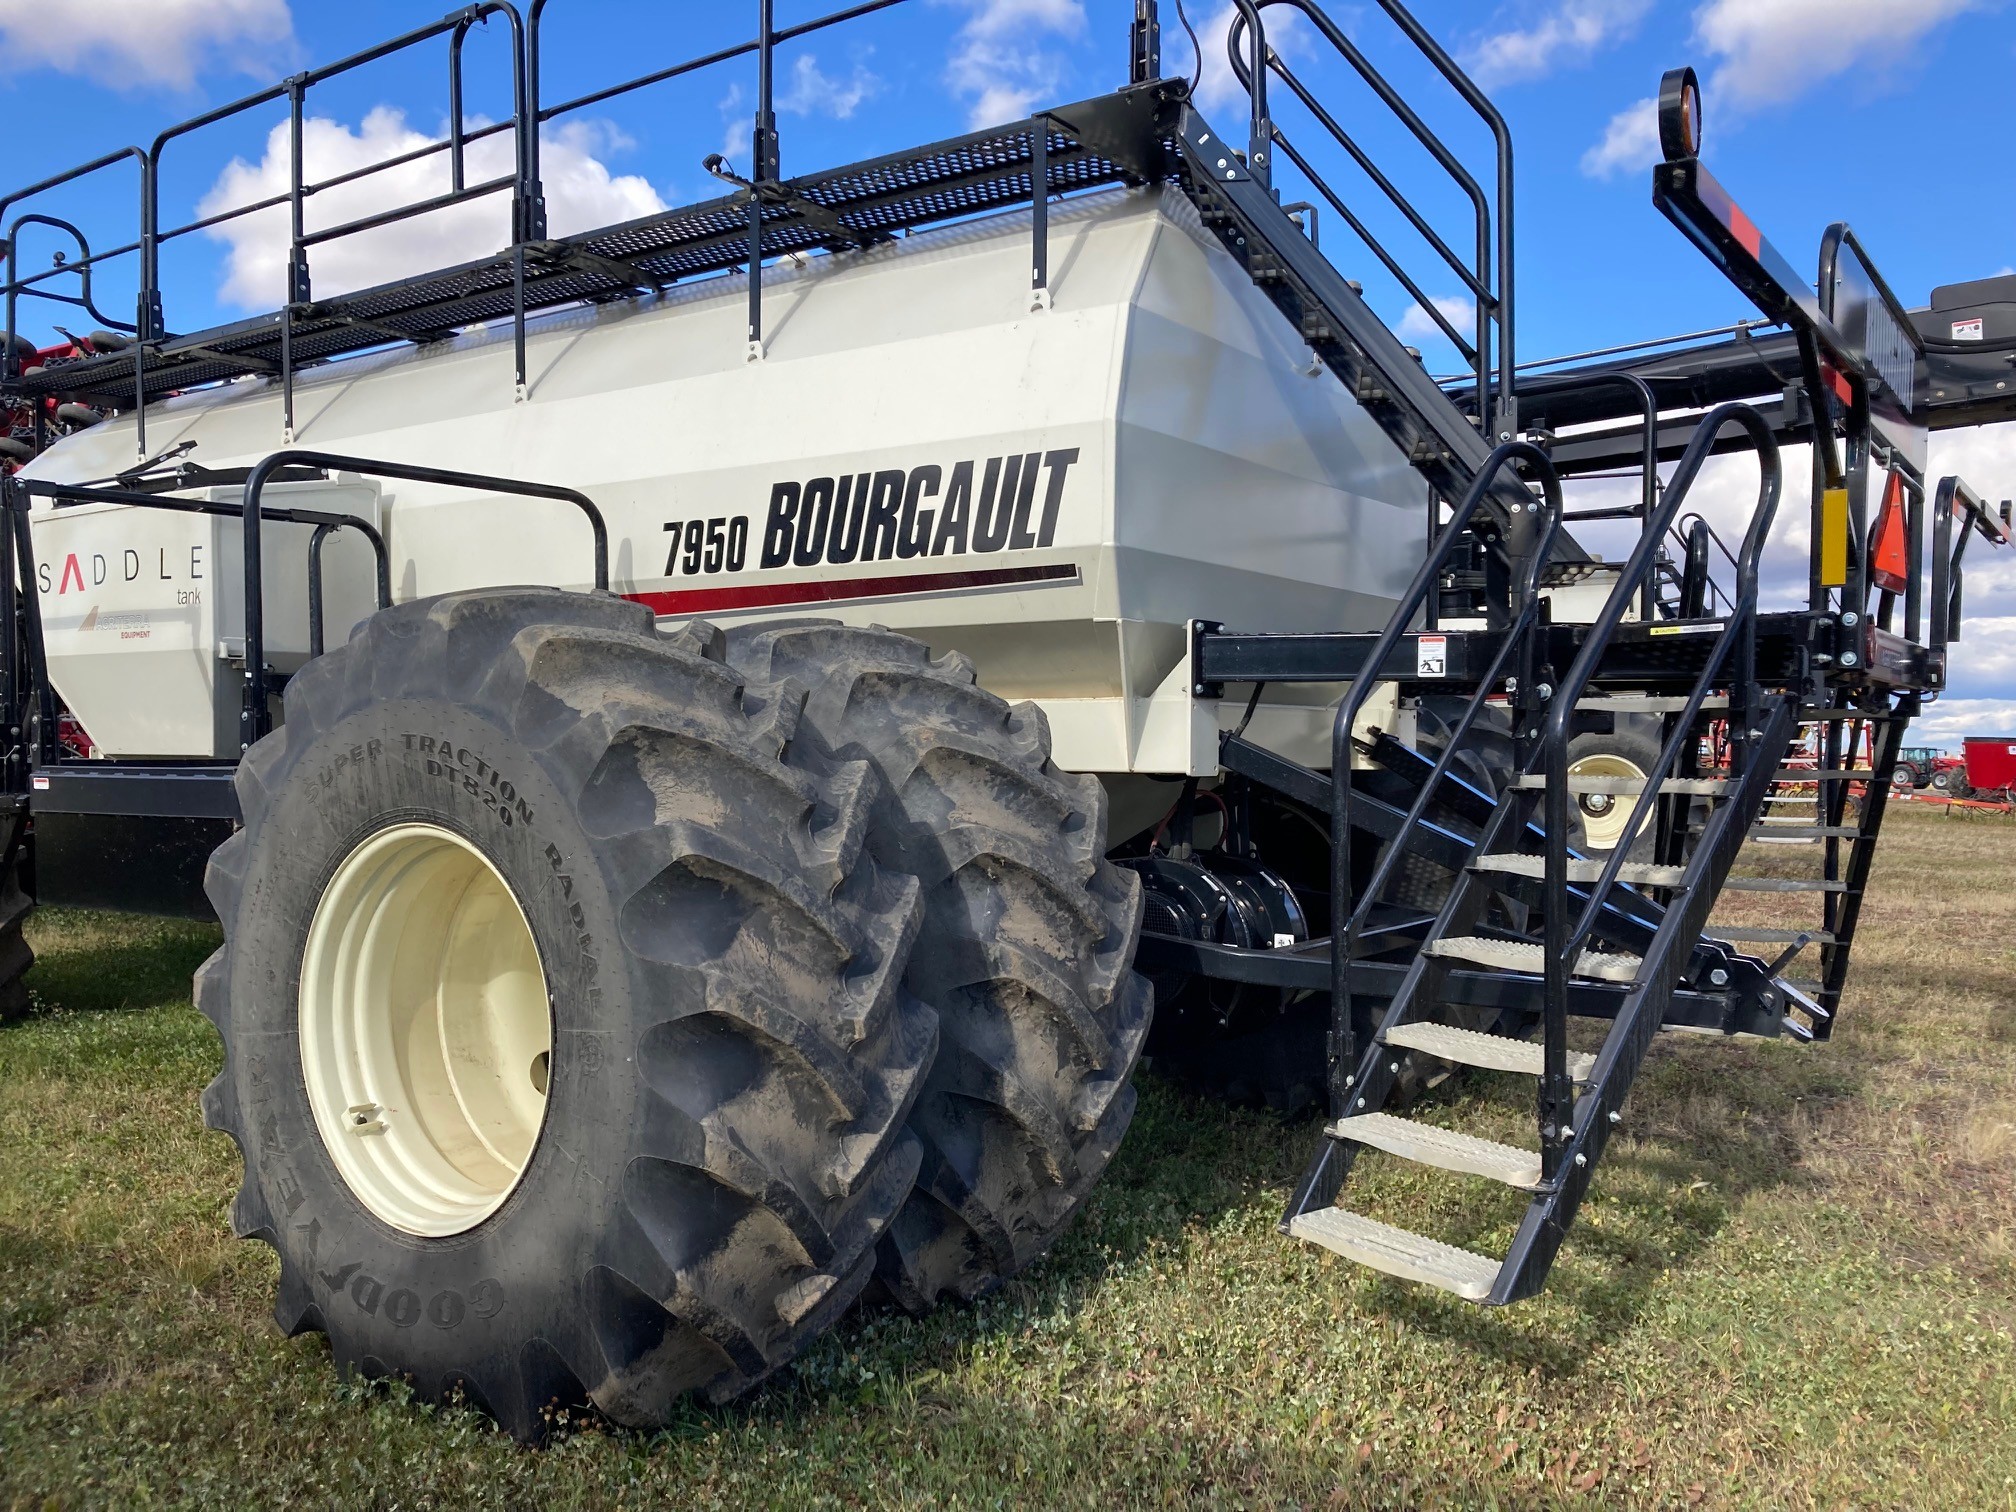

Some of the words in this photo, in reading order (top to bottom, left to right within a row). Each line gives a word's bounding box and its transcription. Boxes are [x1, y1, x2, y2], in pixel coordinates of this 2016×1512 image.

[662, 515, 750, 577] 7950
[759, 446, 1081, 571] BOURGAULT
[38, 546, 204, 595] SADDLE
[177, 587, 202, 605] tank
[120, 630, 151, 639] EQUIPMENT
[304, 738, 383, 805] SUPER
[400, 733, 535, 827] TRACTION
[426, 759, 513, 828] DT820
